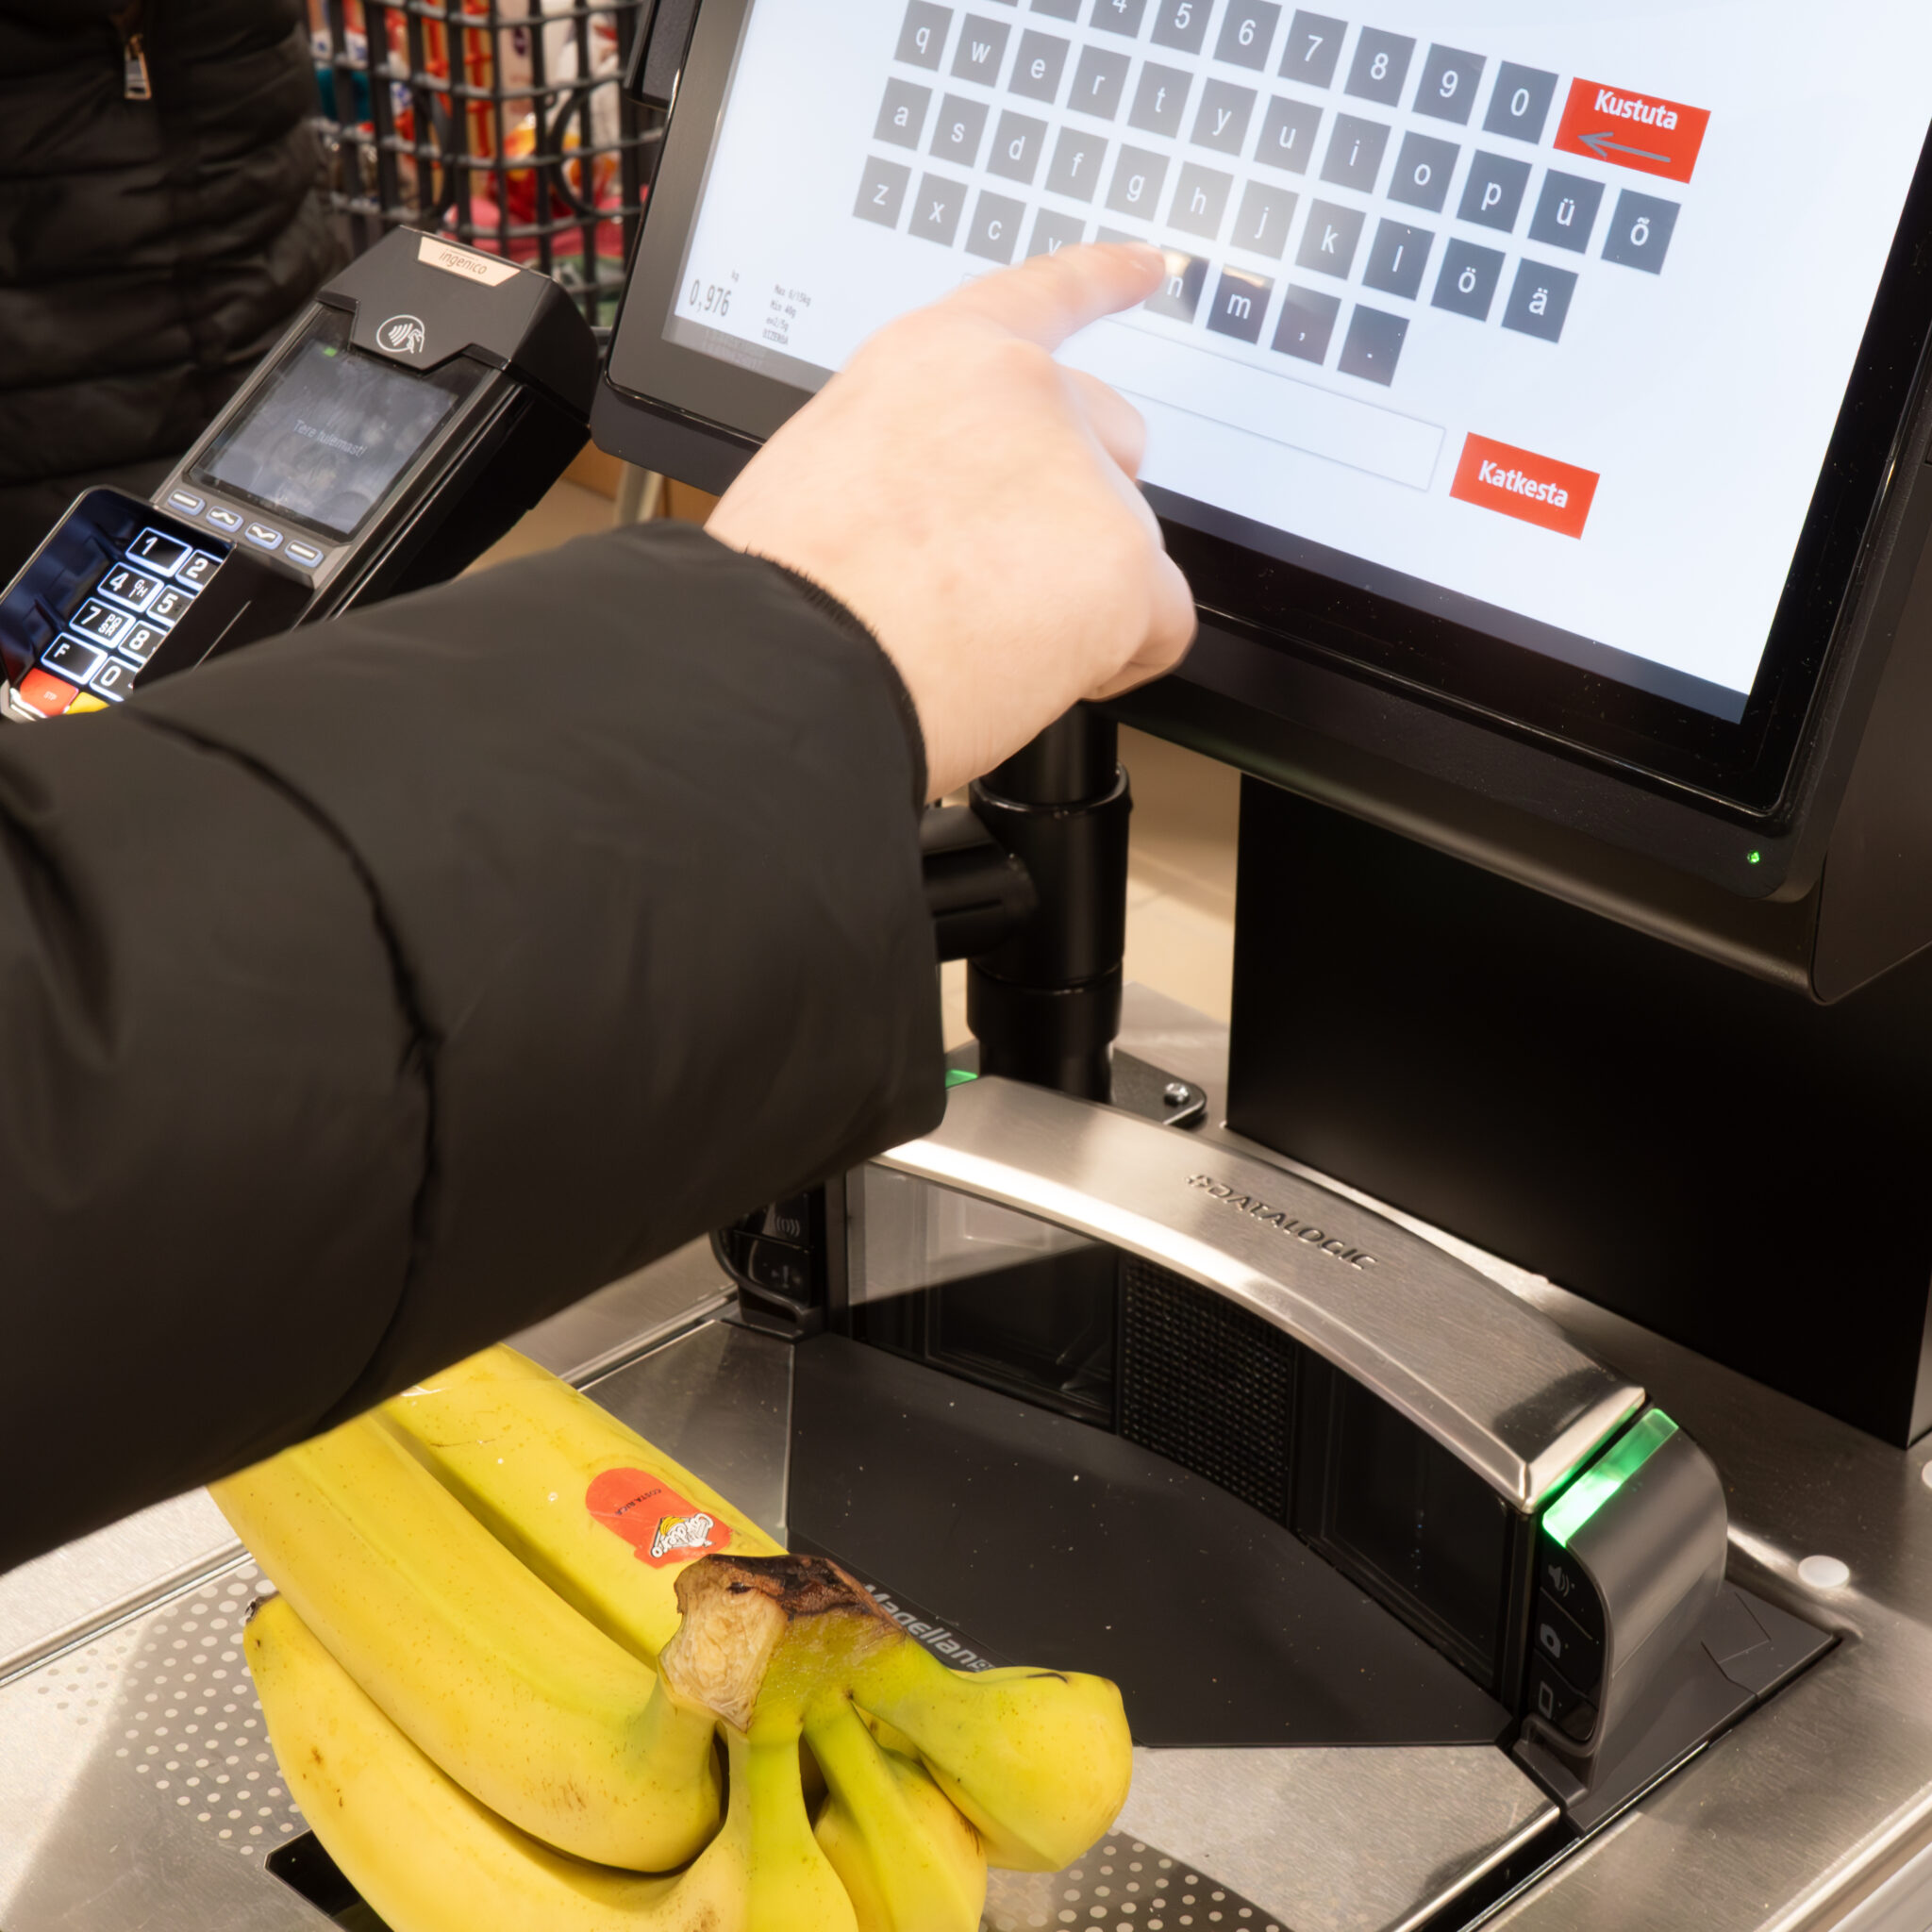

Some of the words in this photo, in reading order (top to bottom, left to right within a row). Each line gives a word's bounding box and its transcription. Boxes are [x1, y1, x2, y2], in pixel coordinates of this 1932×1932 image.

[1174, 2, 1193, 29] 5
[1238, 19, 1257, 46] 6
[1305, 34, 1324, 62] 7
[1370, 52, 1390, 80] 8
[1440, 70, 1458, 98] 9
[1510, 88, 1530, 117] 0
[1593, 89, 1678, 130] Kustuta
[915, 26, 931, 55] q
[972, 41, 991, 64] w
[1030, 58, 1046, 79] e
[1091, 75, 1106, 95] r
[1155, 87, 1166, 113] t
[1212, 108, 1232, 137] y
[1279, 125, 1296, 149] u
[1349, 140, 1360, 167] i
[1413, 163, 1431, 186] o
[1481, 182, 1502, 211] p
[1557, 197, 1575, 226] ü
[1630, 217, 1650, 246] õ
[893, 106, 909, 127] a
[951, 123, 965, 143] s
[1008, 135, 1026, 160] d
[1071, 152, 1085, 177] f
[1126, 175, 1145, 203] g
[1190, 187, 1207, 215] h
[1254, 207, 1270, 240] j
[1321, 225, 1339, 254] k
[1457, 266, 1476, 293] ö
[1528, 287, 1548, 316] ä
[439, 249, 488, 275] ingenico
[873, 184, 890, 206] z
[928, 201, 945, 223] x
[988, 220, 1003, 241] c
[1166, 275, 1184, 300] n
[1226, 293, 1252, 320] m
[690, 279, 732, 317] 0,976
[293, 420, 316, 438] Tere
[318, 427, 369, 458] tulemast!
[1478, 459, 1569, 508] Katkesta
[142, 536, 158, 556] 1
[109, 572, 129, 591] 4
[186, 558, 208, 579] 2
[81, 606, 102, 625] 7
[157, 592, 178, 613] 5
[54, 642, 71, 658] F
[129, 629, 150, 650] 8
[100, 665, 122, 687] 0
[1207, 1183, 1378, 1270] DATALOGIC
